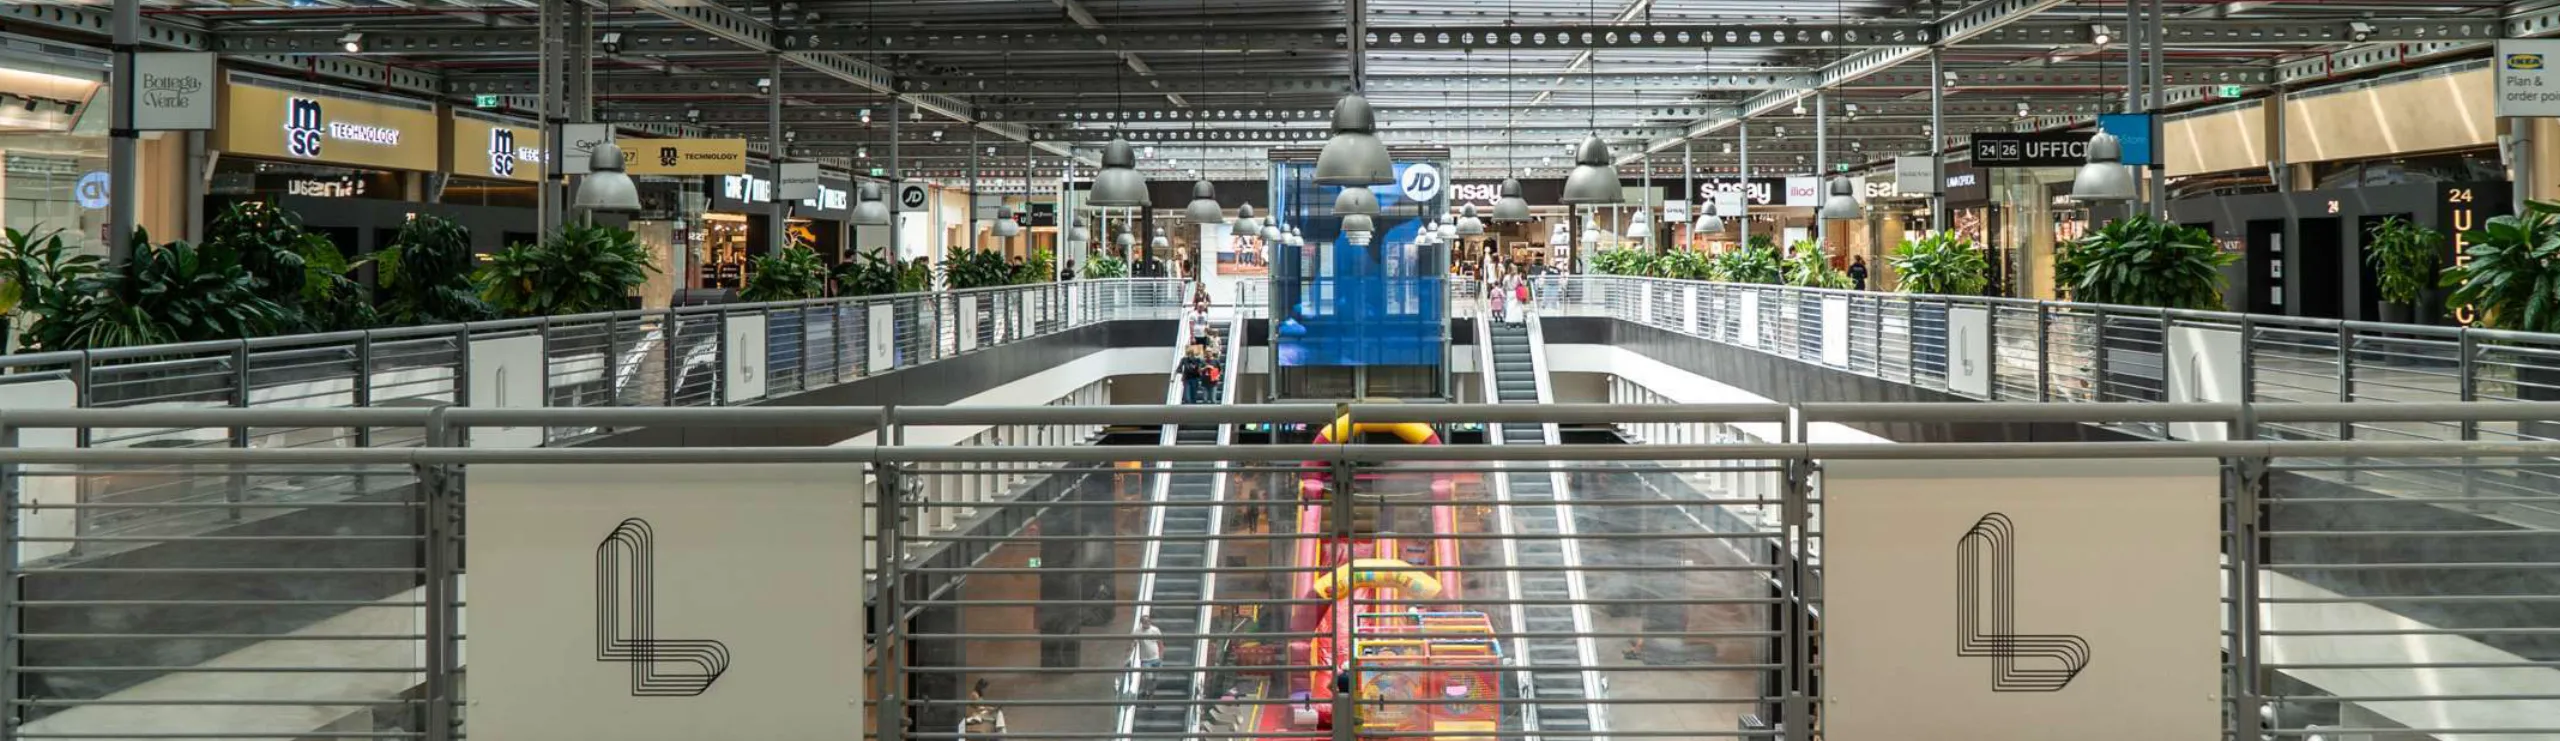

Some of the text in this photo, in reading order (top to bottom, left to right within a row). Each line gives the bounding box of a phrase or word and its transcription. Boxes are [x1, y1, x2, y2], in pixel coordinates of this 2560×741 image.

[144, 73, 202, 94] Bottega
[2506, 76, 2543, 86] Plan &
[143, 89, 189, 108] Verde
[2507, 90, 2538, 101] order
[329, 122, 400, 145] TECHNOLOGY
[1981, 142, 2088, 158] 24 26 UFFICI
[1406, 172, 1436, 192] JD
[904, 190, 922, 203] JD
[1450, 183, 1502, 205] nsay
[1790, 185, 1815, 197] iliad
[2448, 188, 2473, 203] 24
